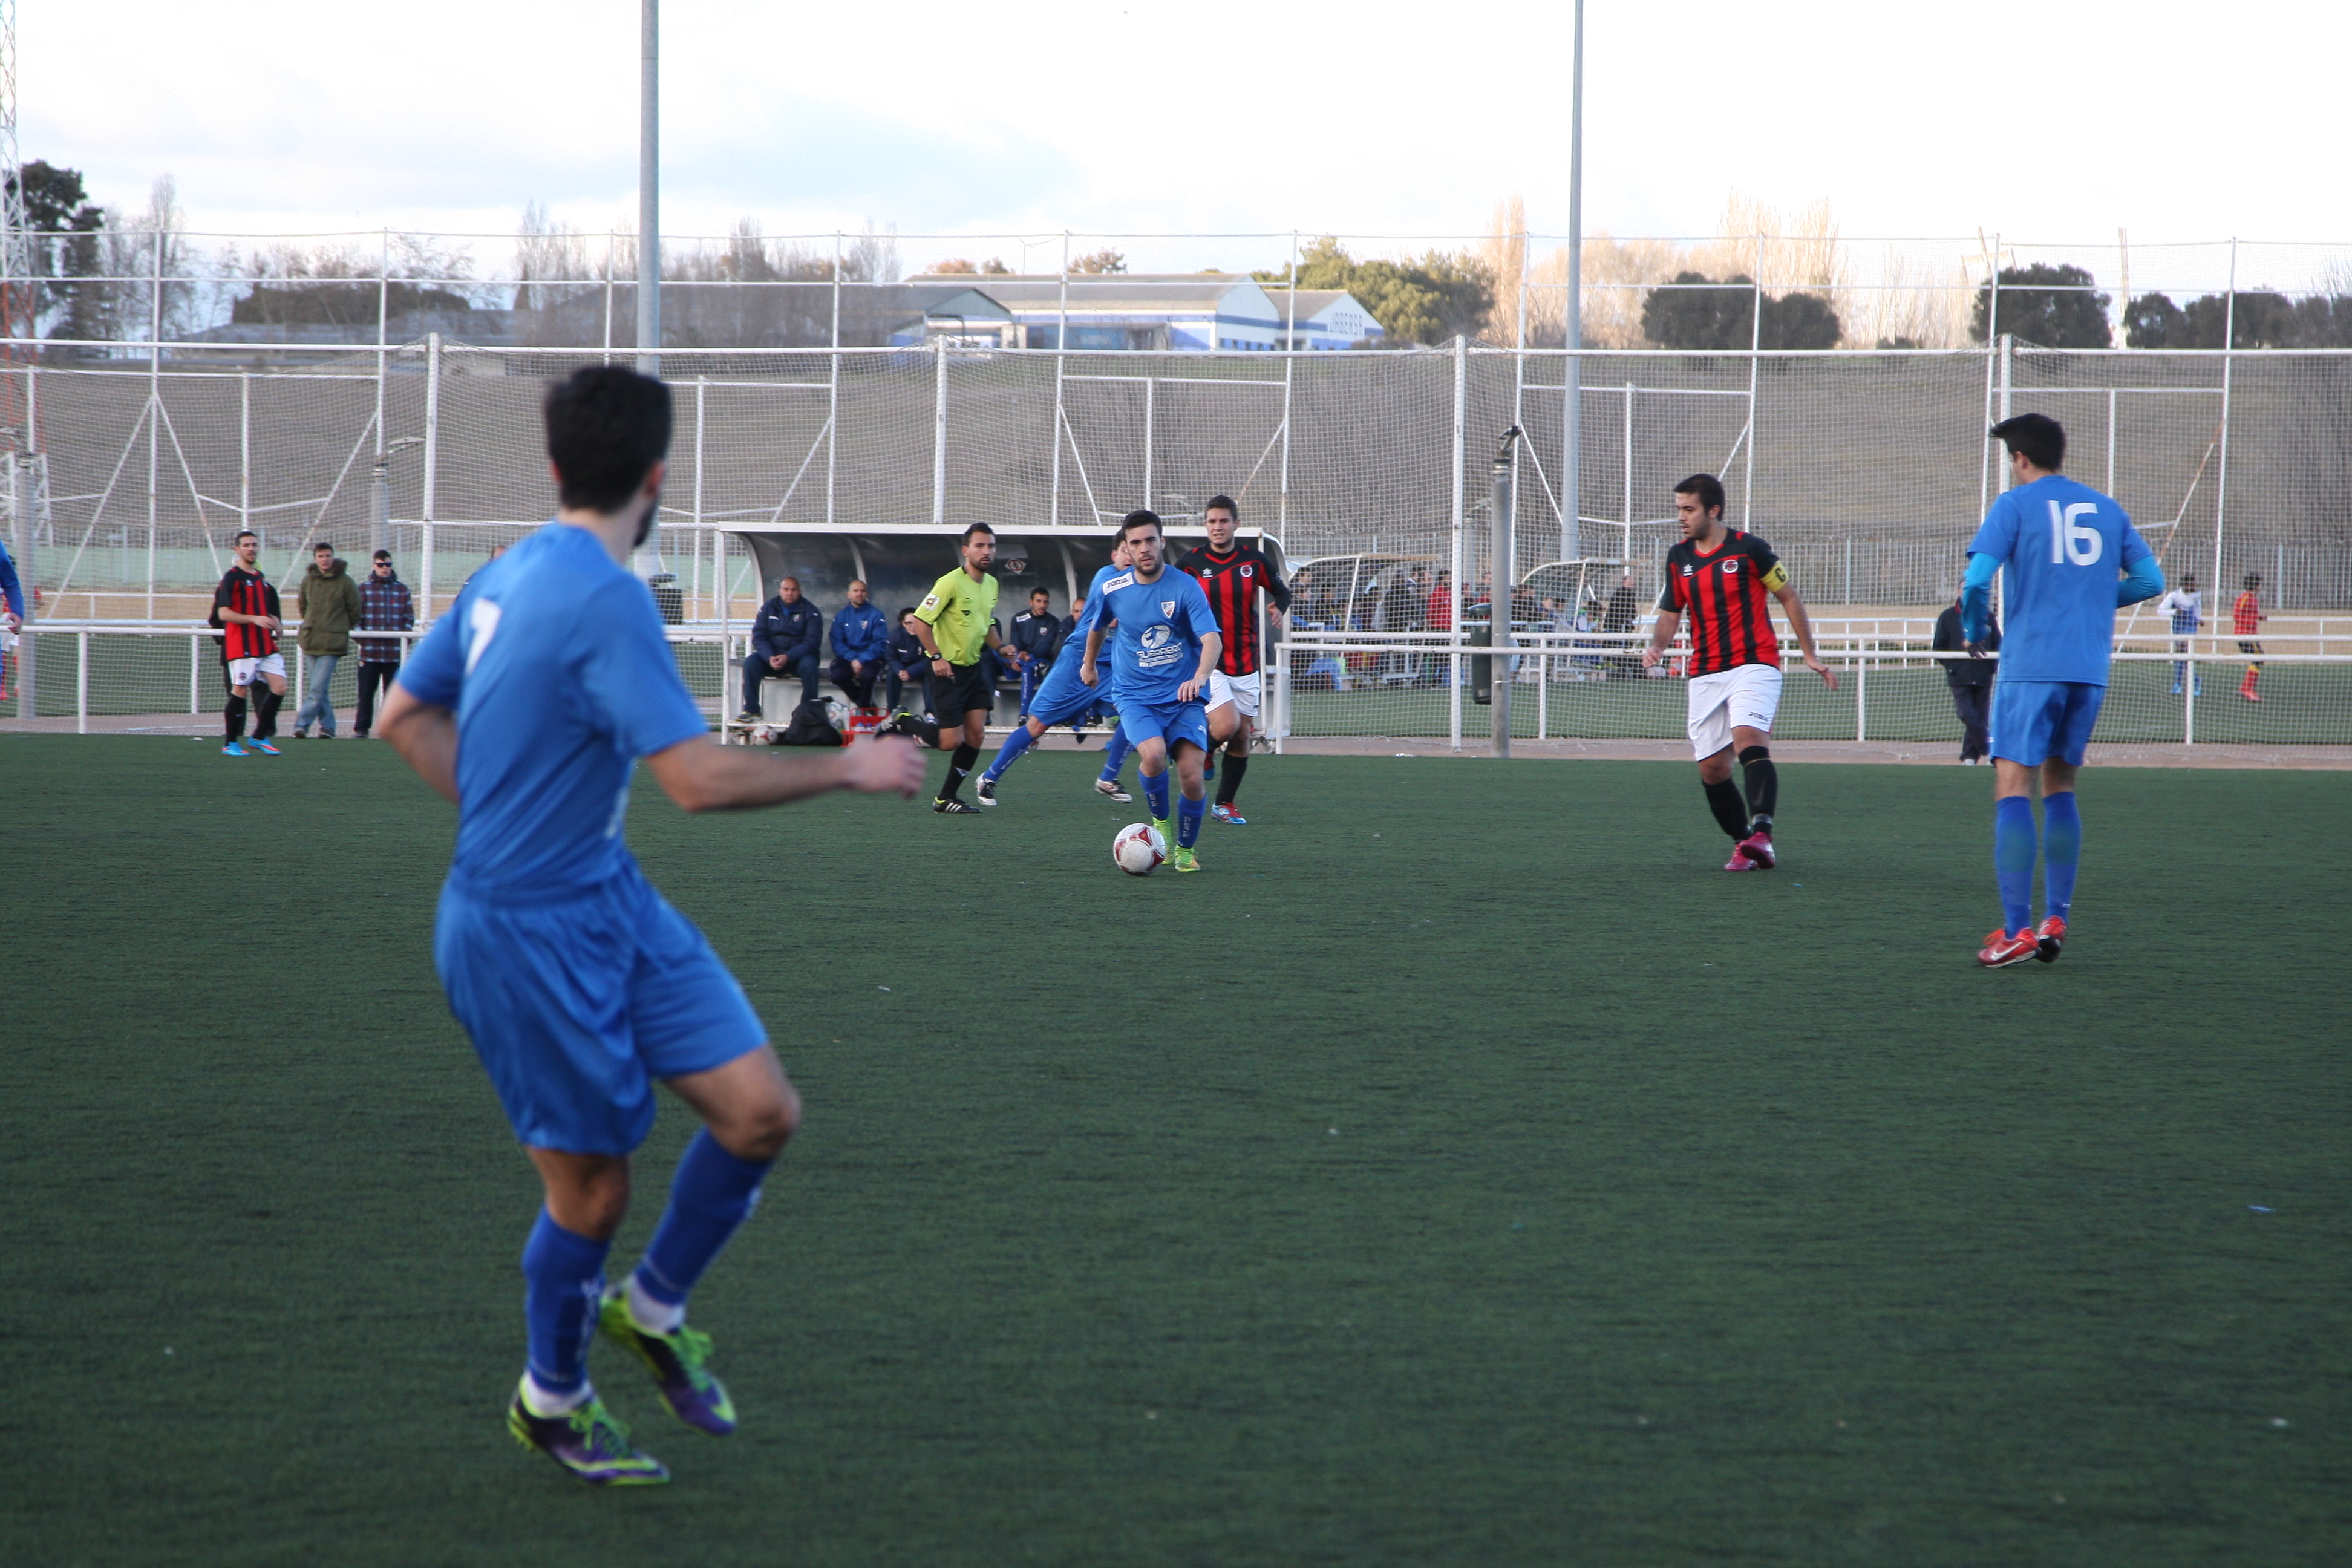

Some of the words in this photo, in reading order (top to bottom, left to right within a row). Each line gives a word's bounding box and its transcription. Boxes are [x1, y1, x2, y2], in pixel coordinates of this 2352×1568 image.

[2048, 500, 2102, 566] 16
[1775, 568, 1786, 582] C
[1136, 642, 1182, 658] GUERRERO
